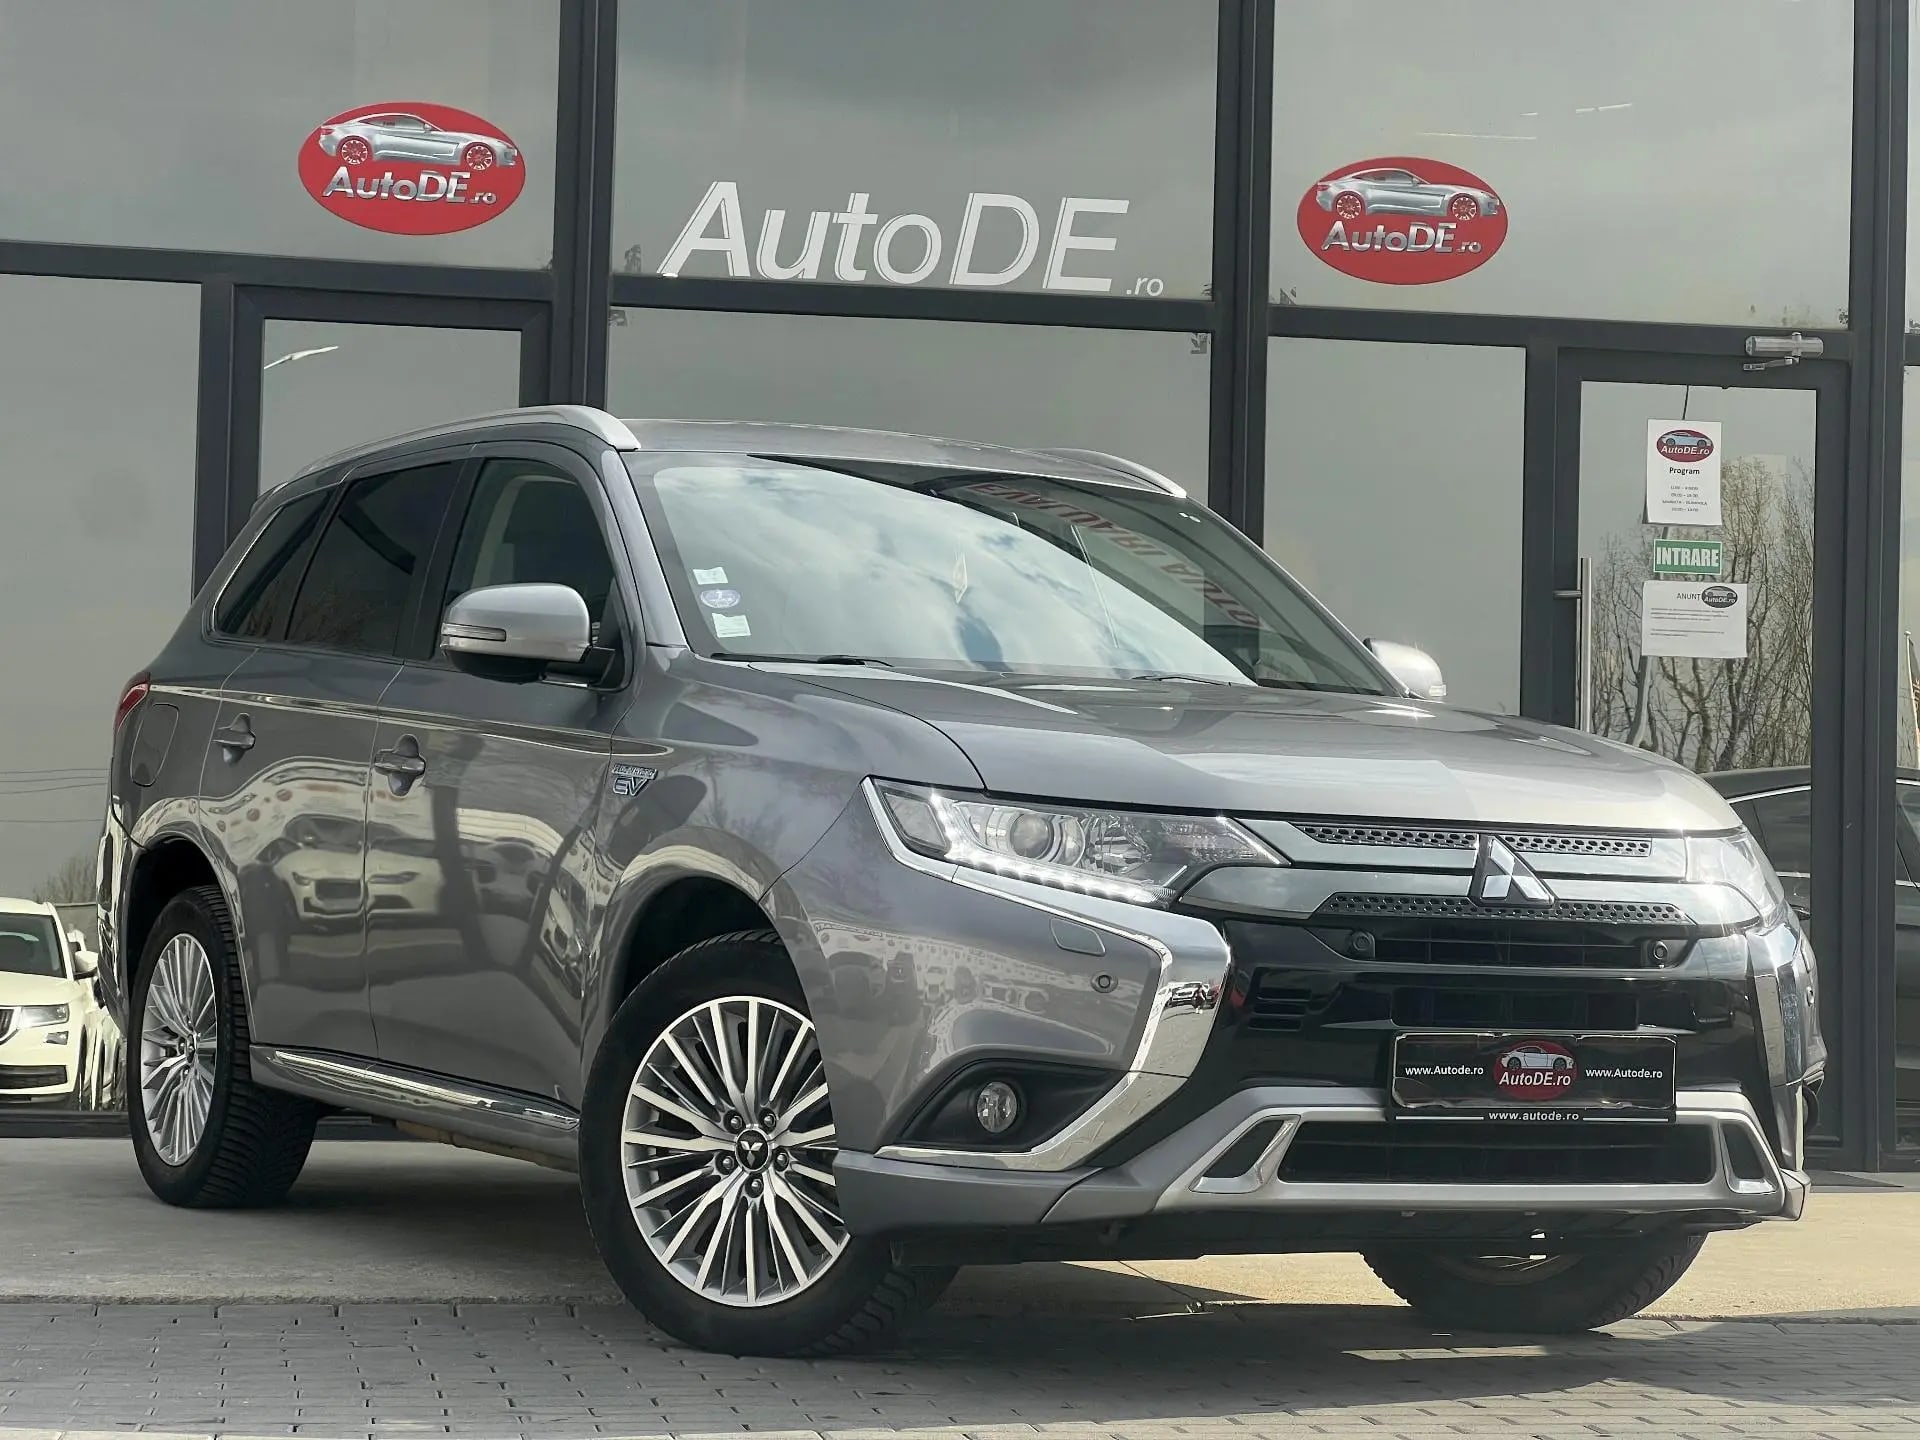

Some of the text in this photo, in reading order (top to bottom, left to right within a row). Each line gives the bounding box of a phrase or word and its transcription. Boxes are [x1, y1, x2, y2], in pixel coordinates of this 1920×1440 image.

[1669, 467, 1700, 475] Program
[1656, 546, 1720, 567] INTRARE
[1405, 1065, 1484, 1076] www.Autode.ro
[1585, 1068, 1663, 1079] www.Autode.ro
[1498, 1071, 1571, 1087] AutoDE.ro
[1488, 1110, 1580, 1122] www.autode.ro
